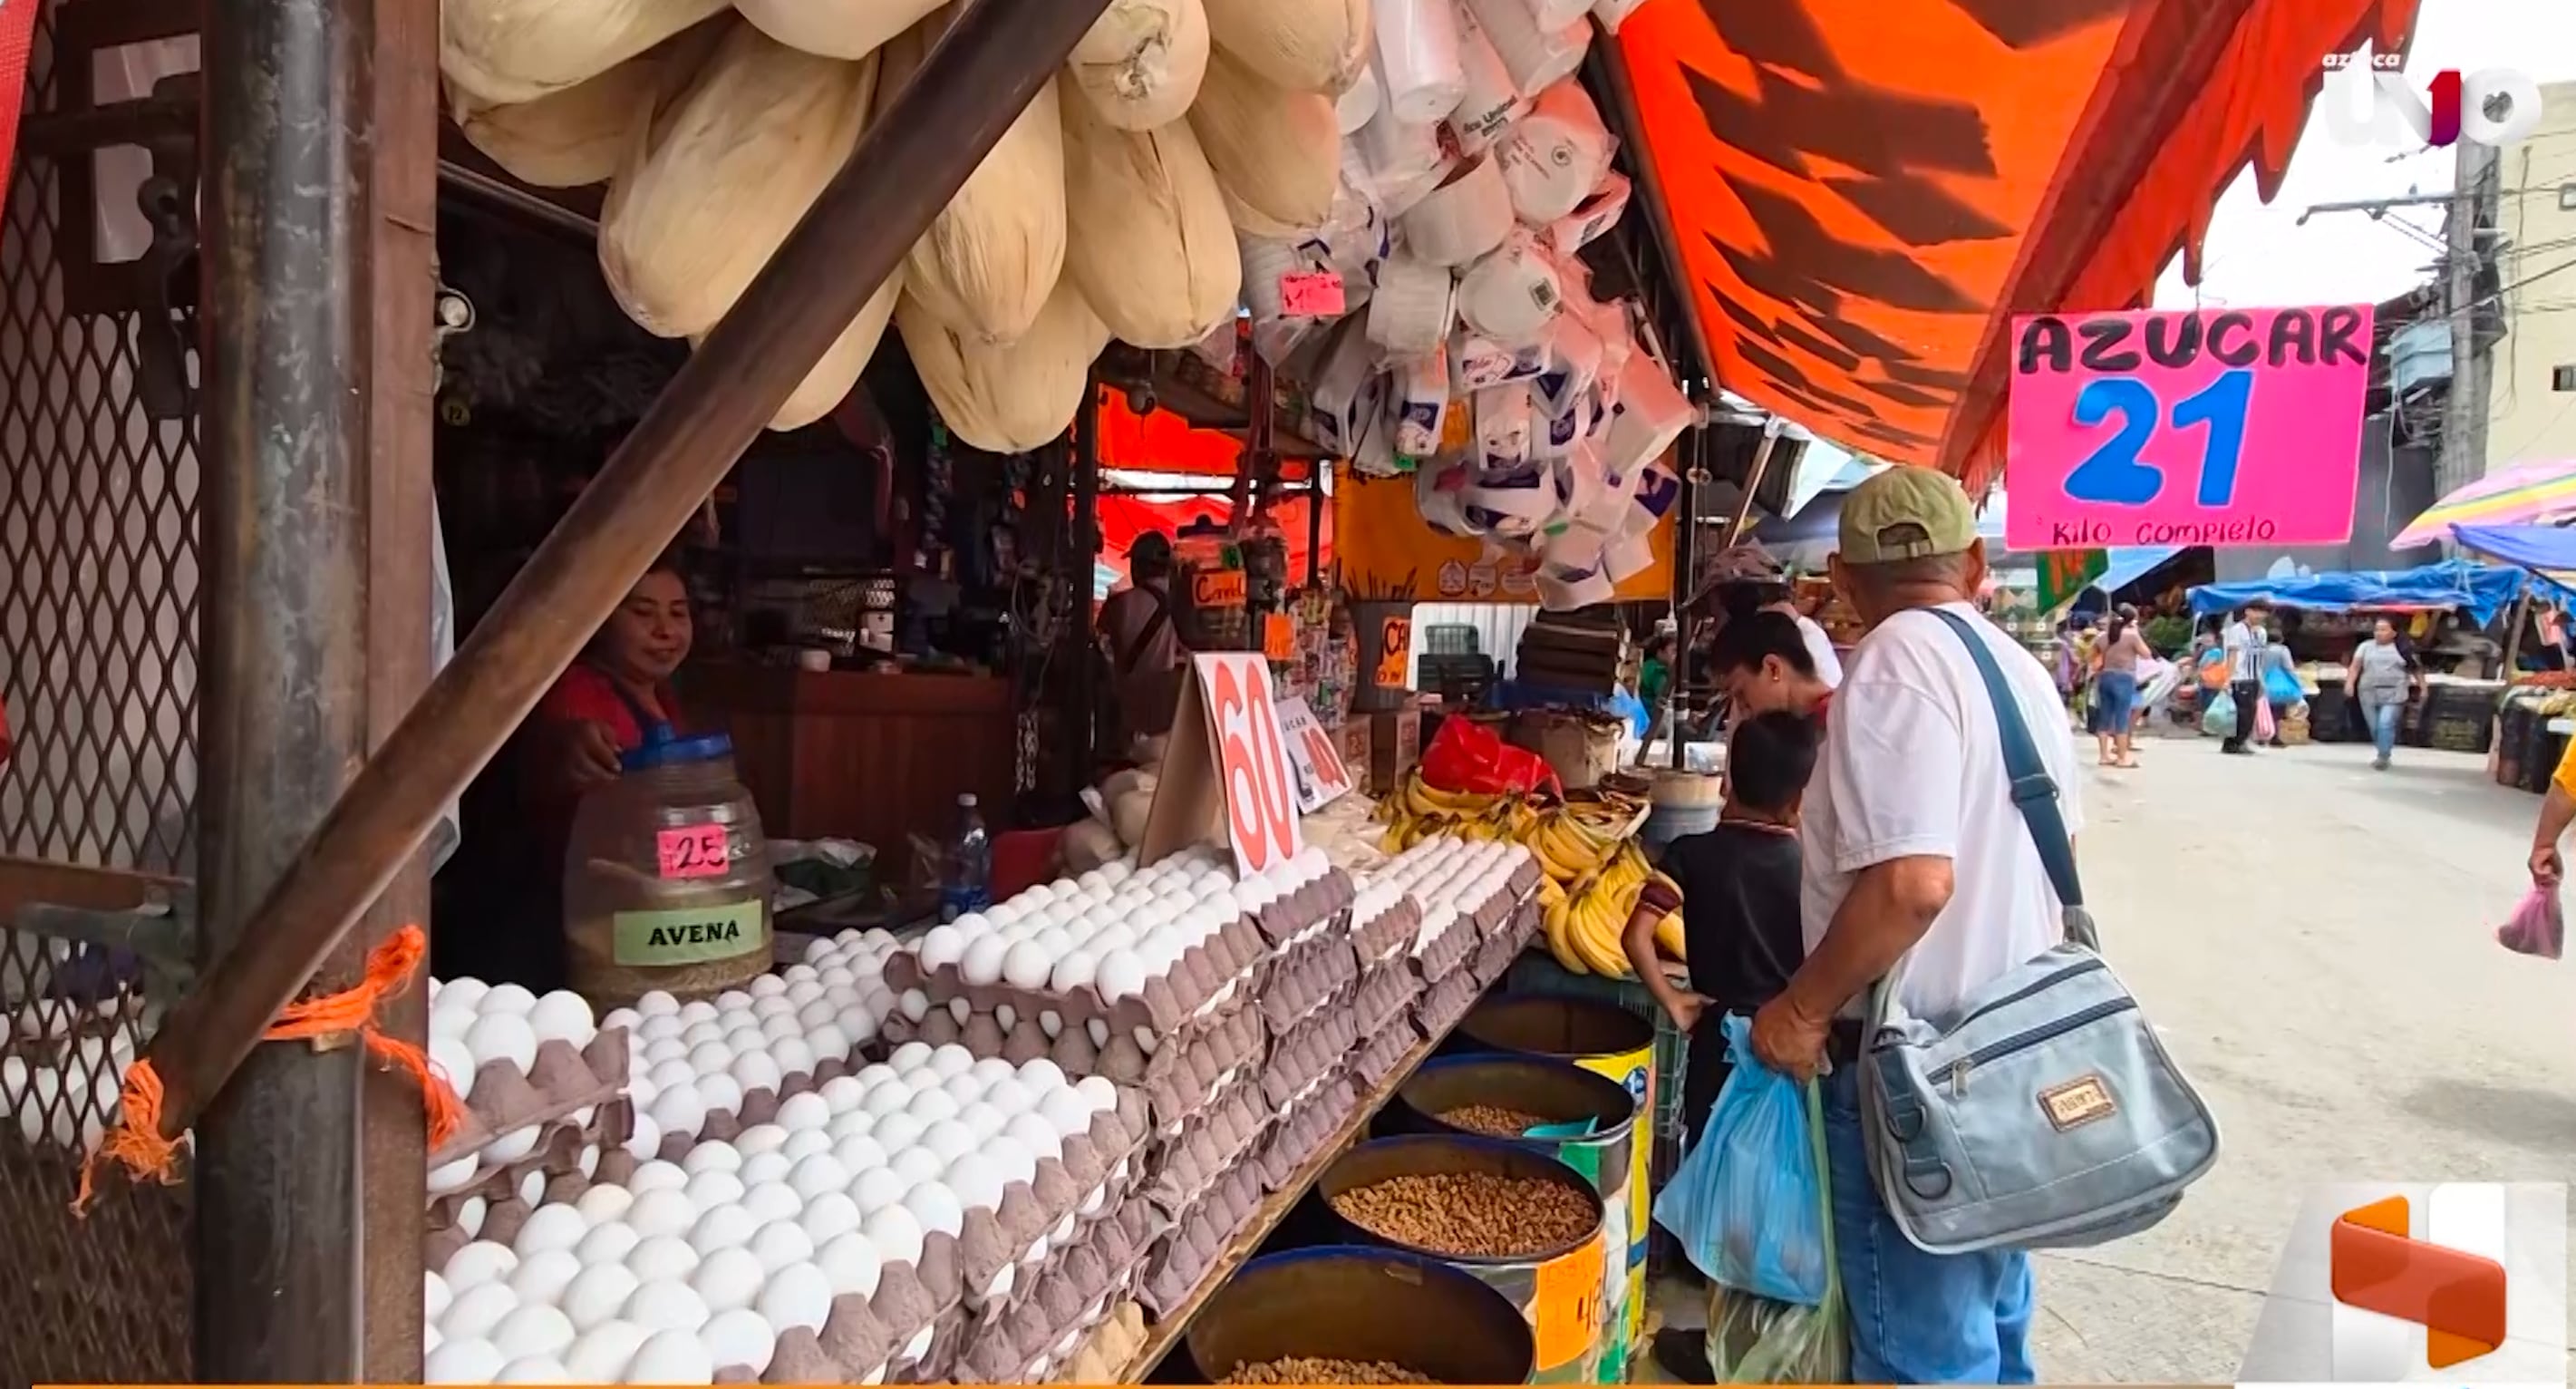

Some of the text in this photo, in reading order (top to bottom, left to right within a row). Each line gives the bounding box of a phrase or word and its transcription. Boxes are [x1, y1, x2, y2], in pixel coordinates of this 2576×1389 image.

[2019, 306, 2368, 374] AZUCAR
[2062, 369, 2254, 507] 21
[1214, 659, 1293, 871] 60
[648, 918, 741, 946] AVENA
